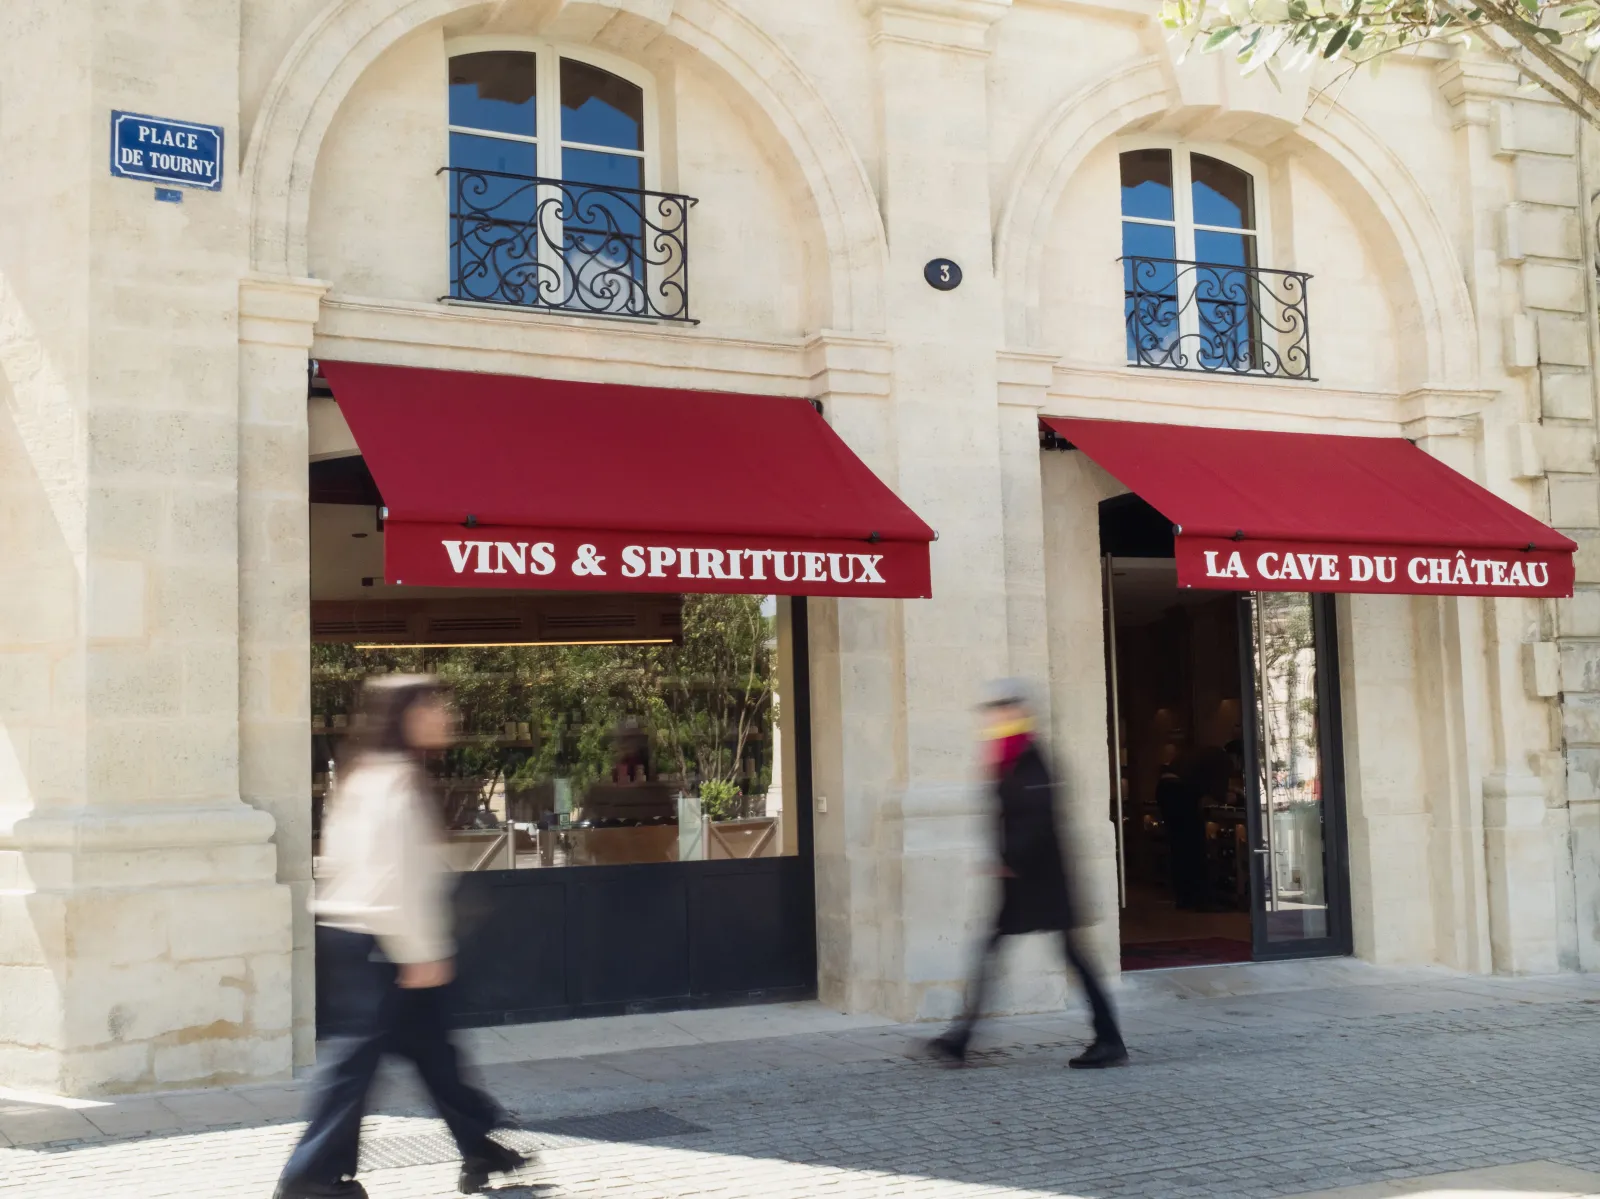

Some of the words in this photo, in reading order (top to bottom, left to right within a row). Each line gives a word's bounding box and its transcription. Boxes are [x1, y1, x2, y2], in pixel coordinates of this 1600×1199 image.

[138, 125, 198, 150] PLACE
[121, 147, 144, 166] DE
[149, 151, 215, 177] TOURNY
[940, 264, 950, 282] 3
[442, 540, 557, 576] VINS
[571, 543, 607, 577] &
[621, 546, 887, 584] SPIRITUEUX
[1203, 550, 1250, 579] LA
[1256, 551, 1340, 581] CAVE
[1348, 555, 1398, 583] DU
[1407, 549, 1549, 587] CHÂTEAU
